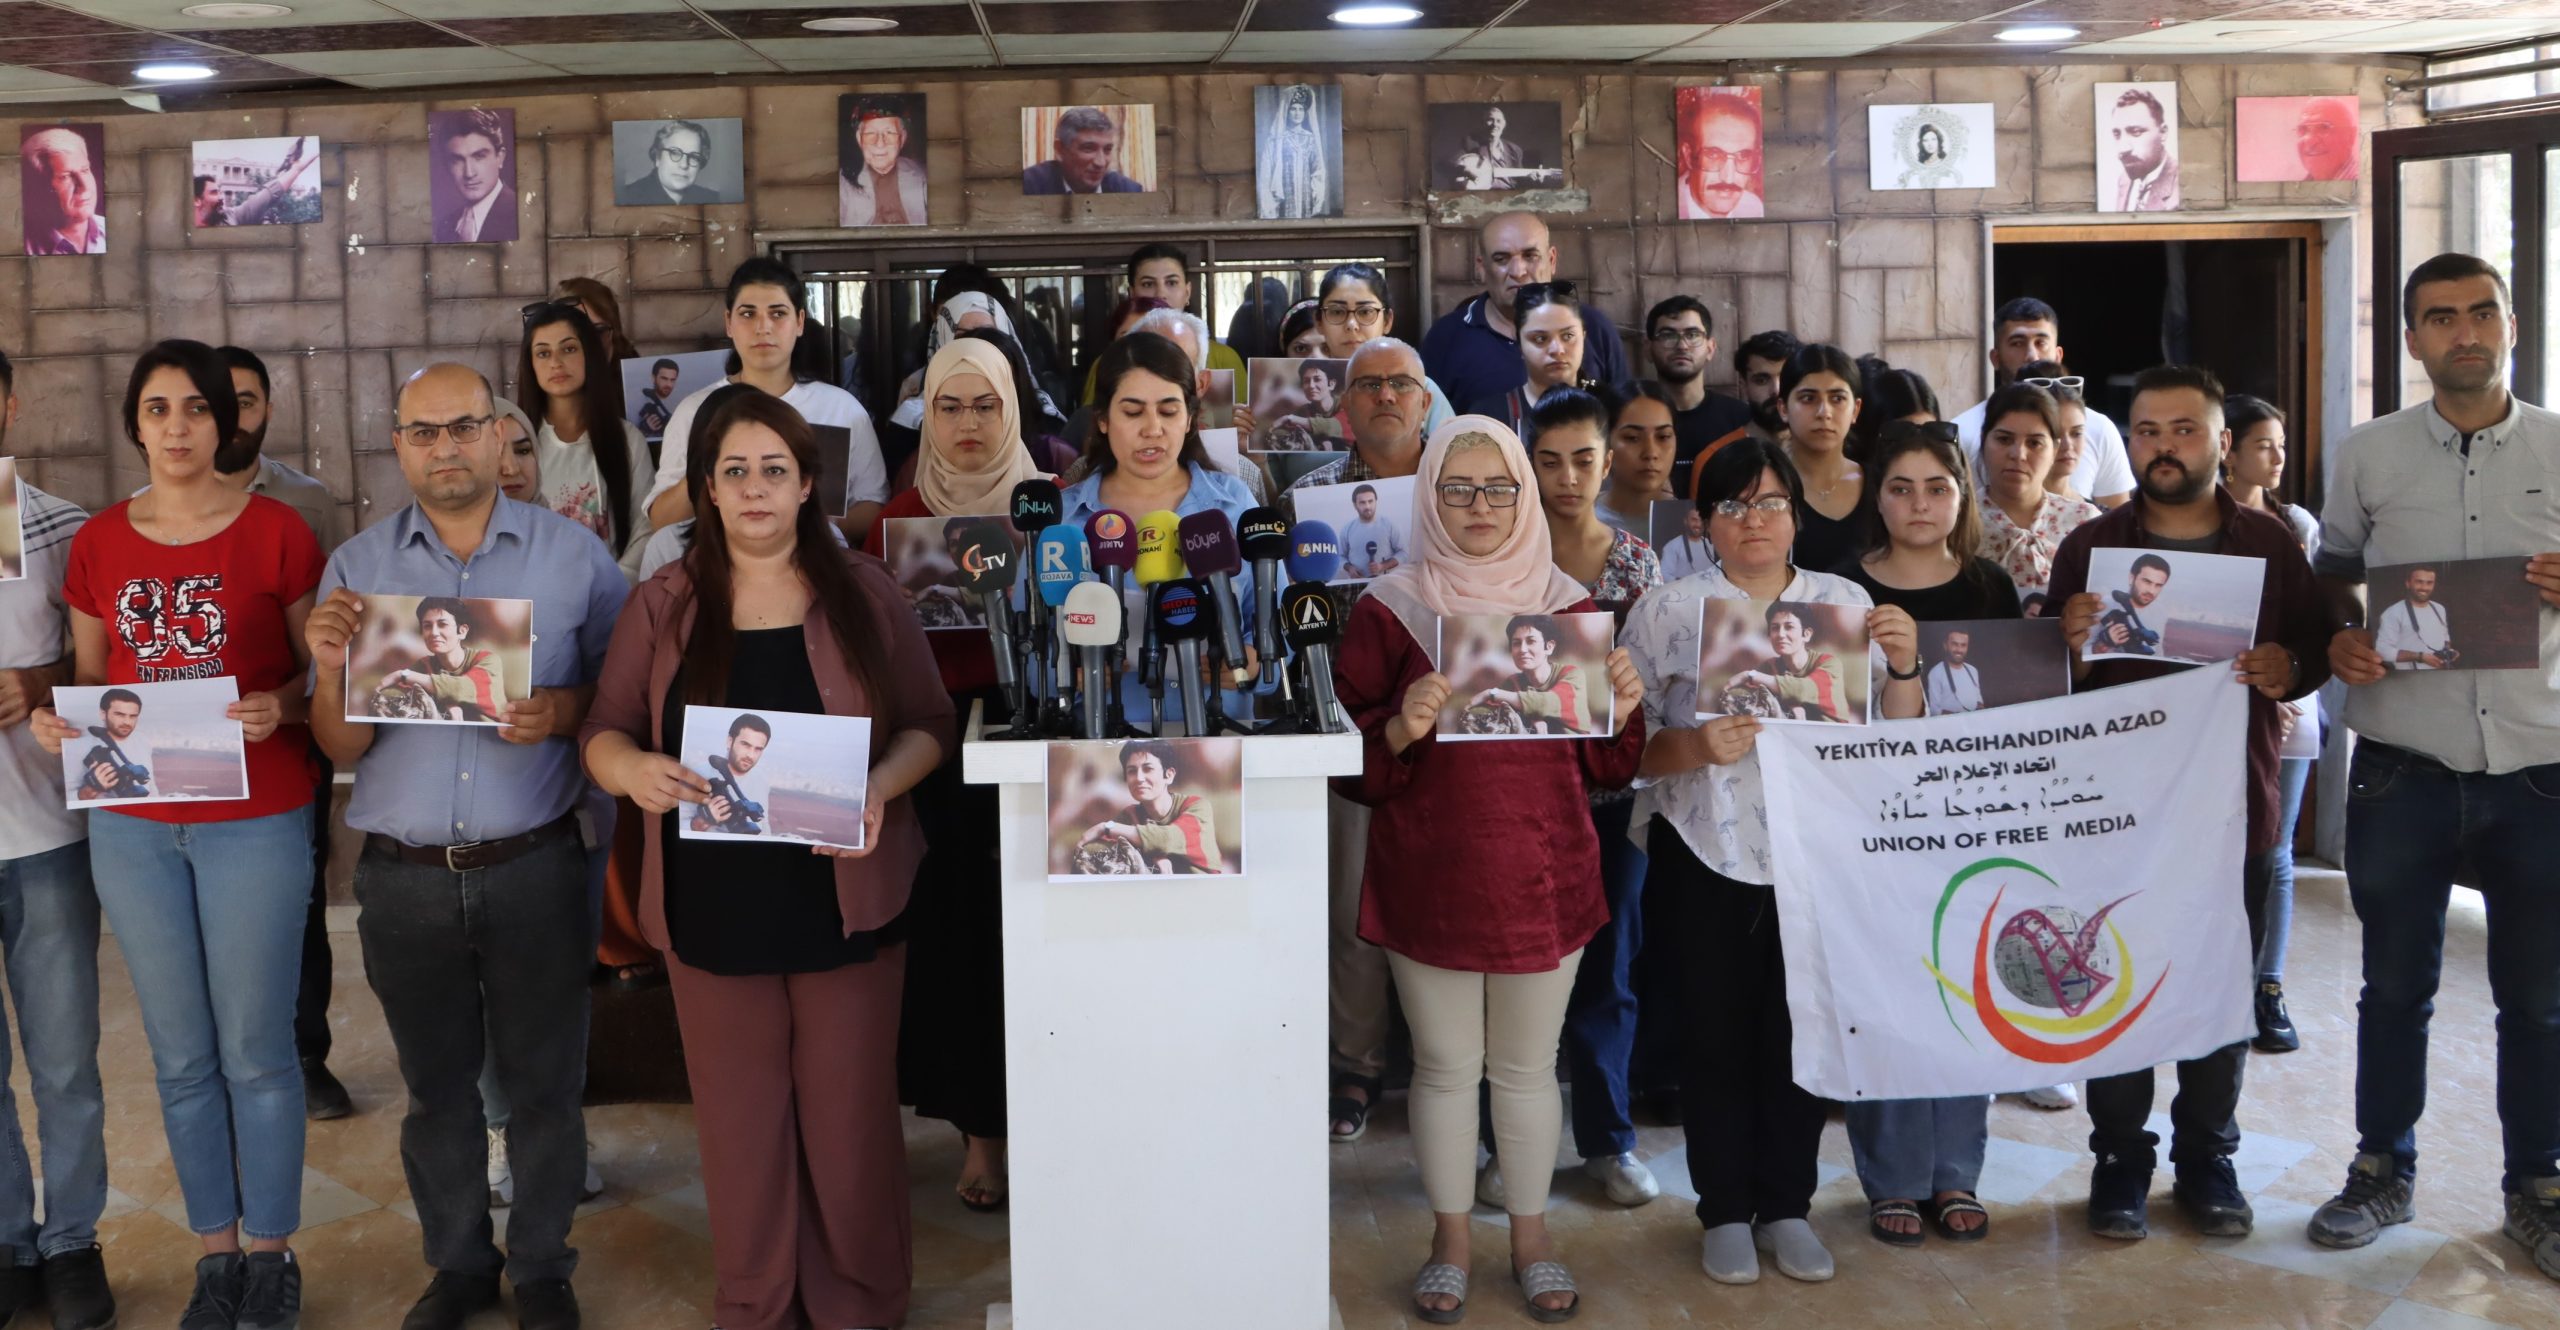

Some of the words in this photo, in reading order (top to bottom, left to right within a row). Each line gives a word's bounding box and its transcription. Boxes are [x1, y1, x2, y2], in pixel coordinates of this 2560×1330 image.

[1042, 541, 1067, 572] R
[1302, 542, 1338, 554] ANHA
[1041, 572, 1073, 582] ROJAVA
[116, 574, 227, 662] 85
[1070, 614, 1094, 624] NEWS
[1171, 606, 1197, 616] HABER
[1298, 622, 1319, 631] ARYEN
[1815, 738, 1917, 761] YEKITÎYA
[1925, 723, 2097, 755] RAGIHANDINA
[2104, 709, 2167, 736] AZAD
[1953, 761, 2008, 784] الإعلام
[2013, 756, 2056, 775] اتحاد
[1913, 766, 1949, 787] الحر
[1862, 835, 1946, 853] UNION
[1954, 832, 1987, 849] OF
[1995, 825, 2050, 846] FREE
[2064, 813, 2137, 839] MEDIA
